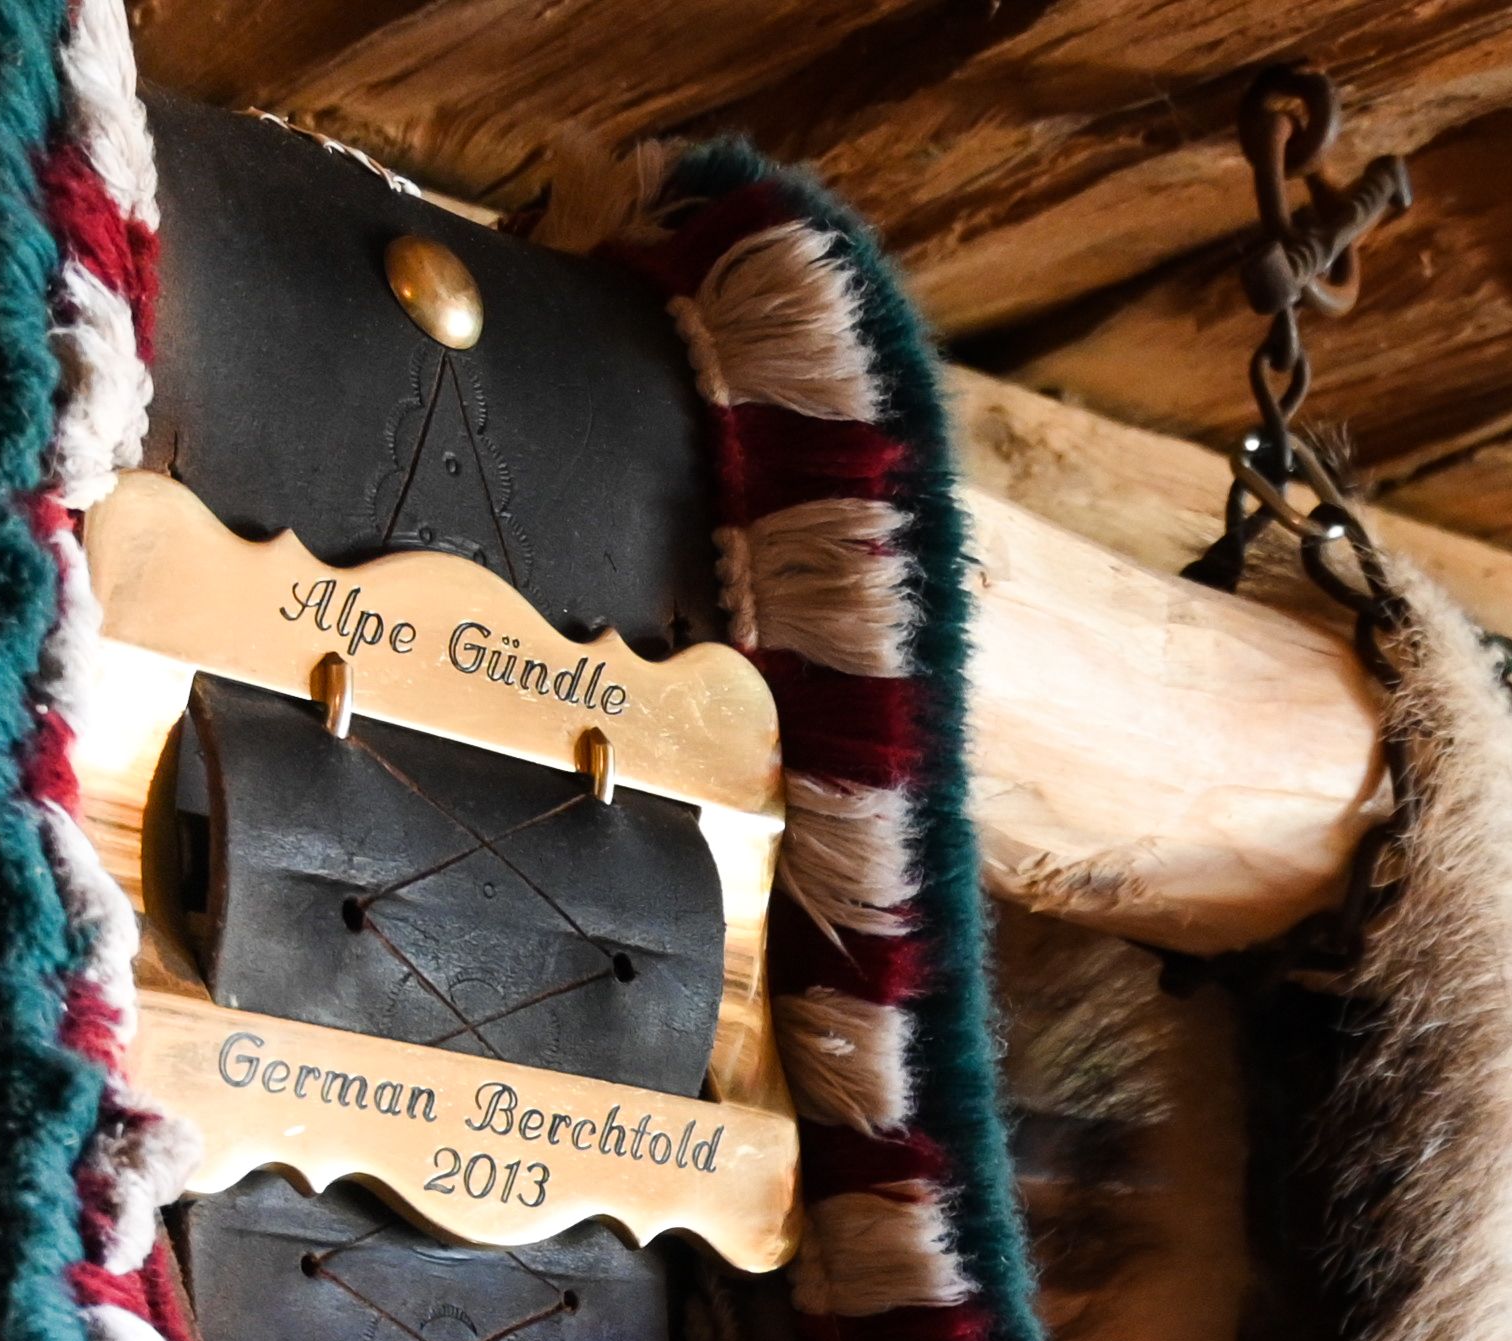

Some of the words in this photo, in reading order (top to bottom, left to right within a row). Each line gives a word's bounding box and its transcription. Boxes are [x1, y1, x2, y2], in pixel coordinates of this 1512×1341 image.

[279, 579, 417, 656] Alpe
[447, 620, 627, 716] Gündle
[217, 1030, 437, 1123] German
[463, 1081, 725, 1174] Berchtold
[422, 1146, 552, 1208] 2013
